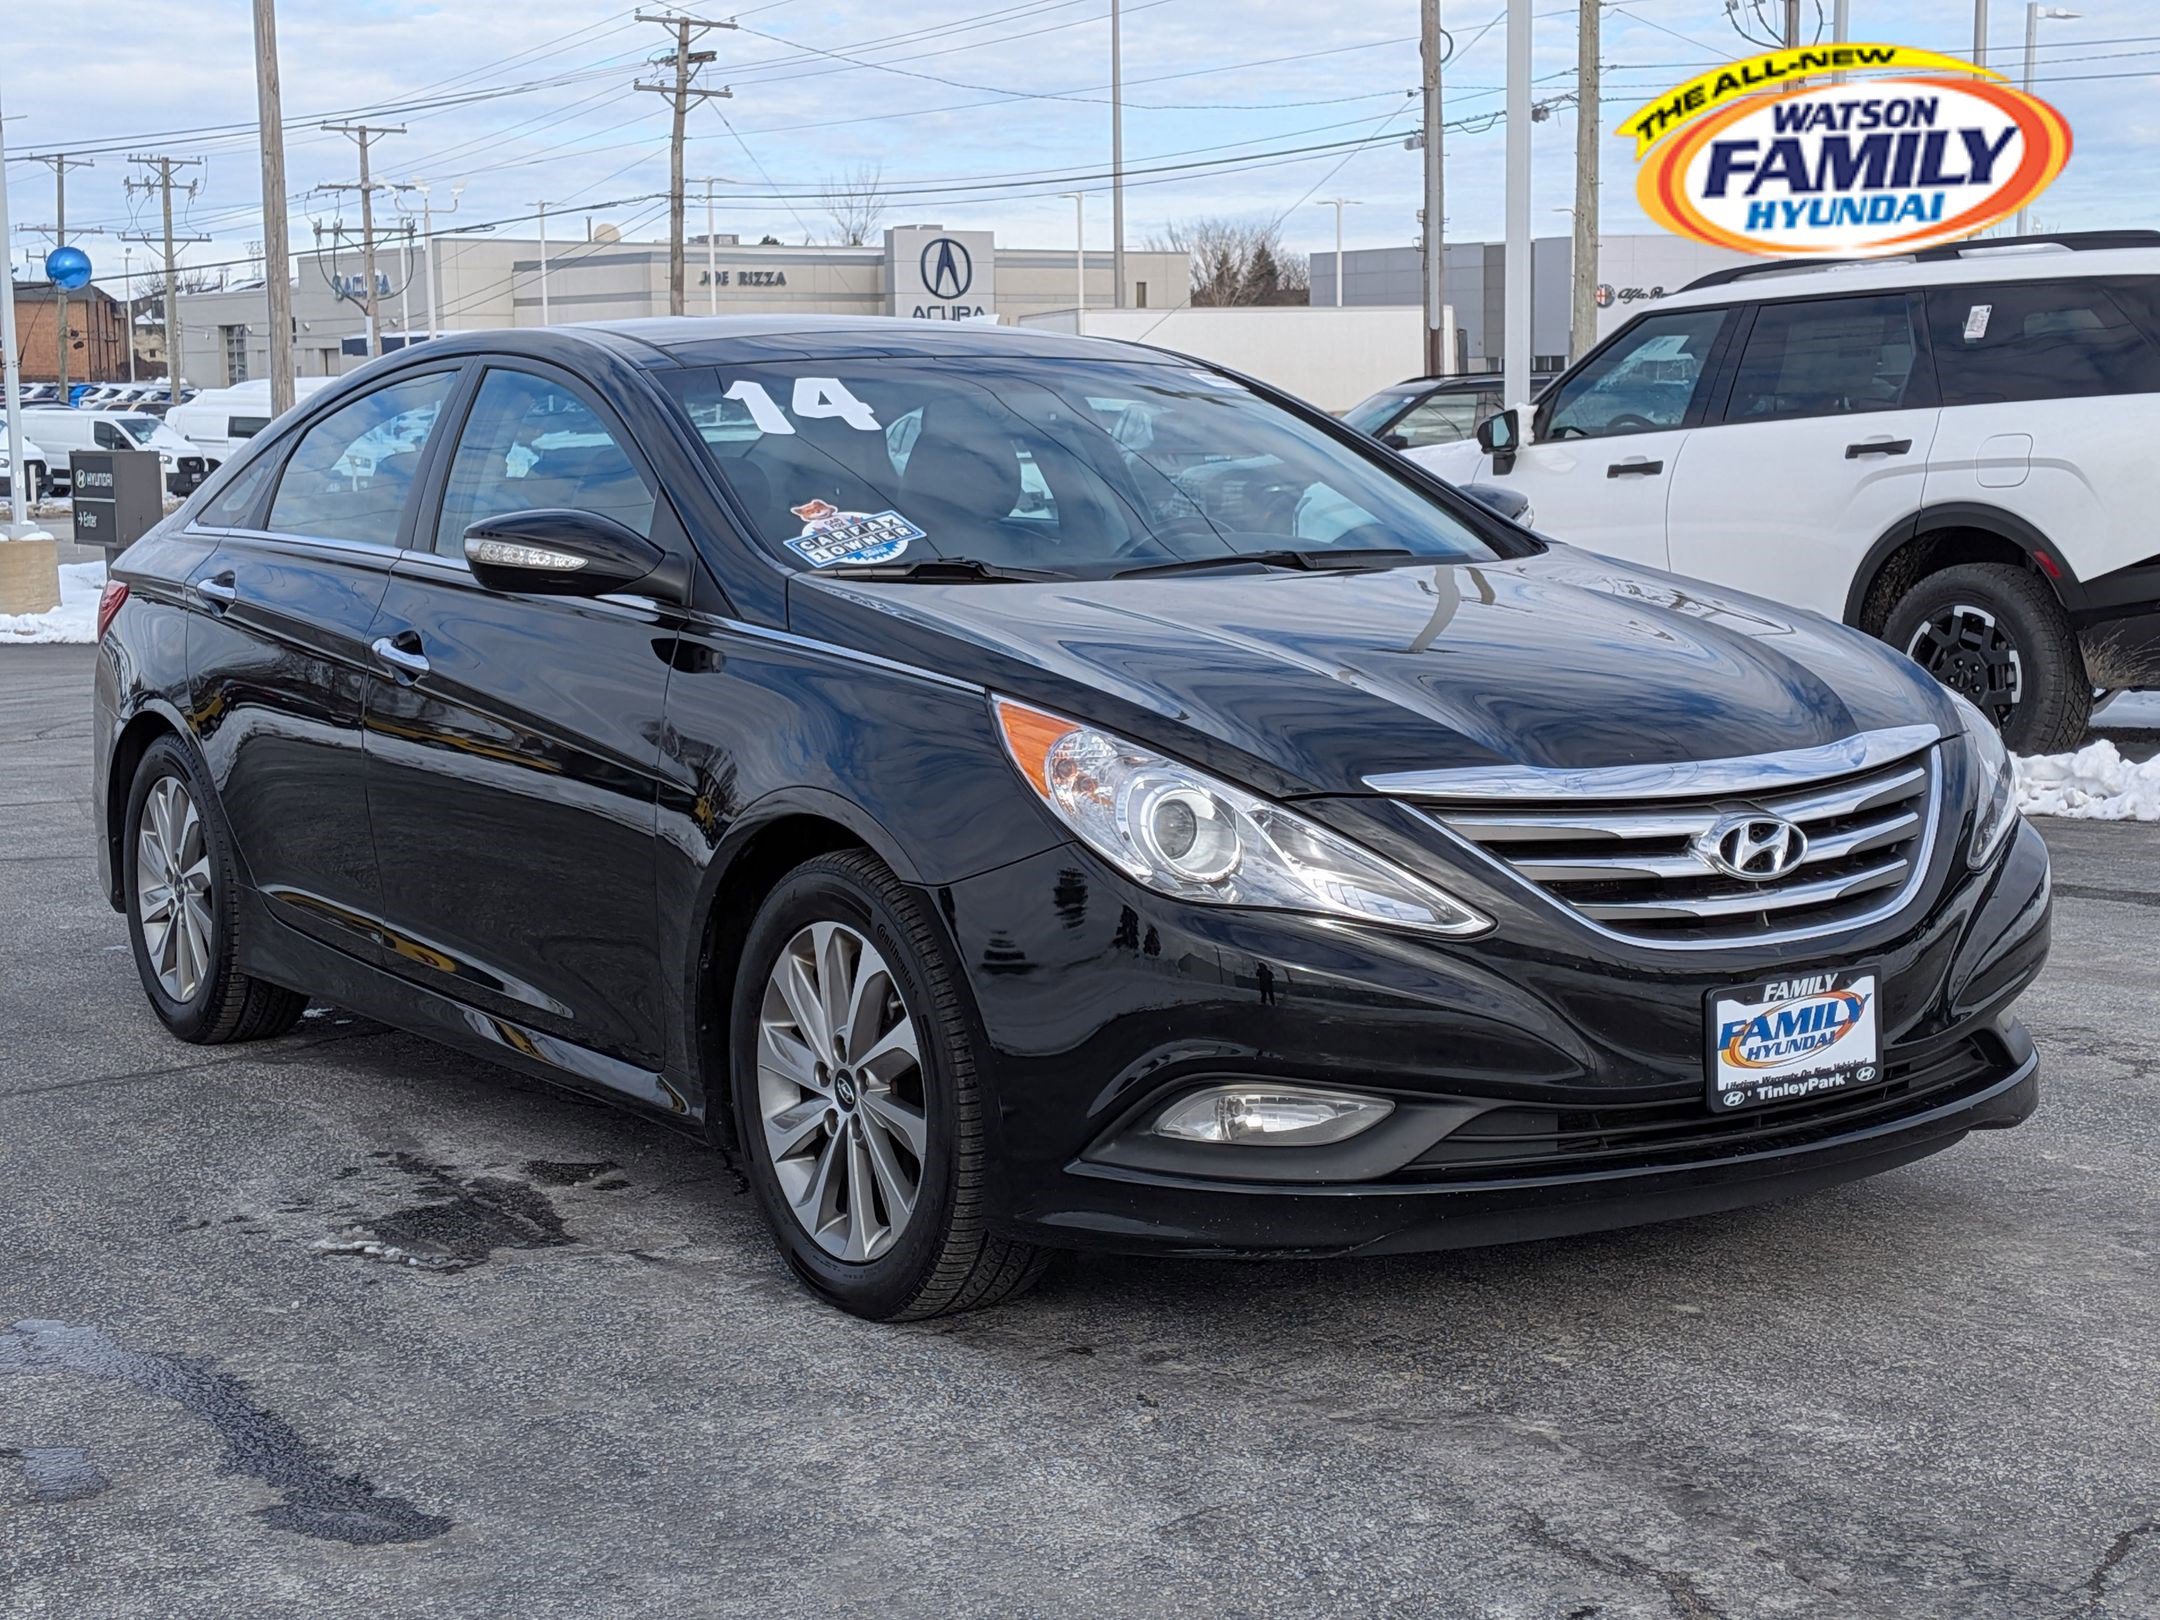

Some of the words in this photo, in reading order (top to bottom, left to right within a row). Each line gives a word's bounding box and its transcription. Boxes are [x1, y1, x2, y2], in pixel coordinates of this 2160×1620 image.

[699, 270, 729, 286] JOE
[737, 270, 787, 286] RIZZA
[722, 377, 883, 435] 14
[86, 472, 113, 487] HYUNDAI
[799, 518, 900, 551] CARFAX
[829, 526, 913, 556] OWNER
[877, 923, 915, 990] Continental
[1763, 972, 1839, 1003] FAMILY
[1717, 993, 1873, 1051] FAMILY
[1745, 1030, 1837, 1062] HYUNDAI
[1756, 1072, 1846, 1101] TinleyPark
